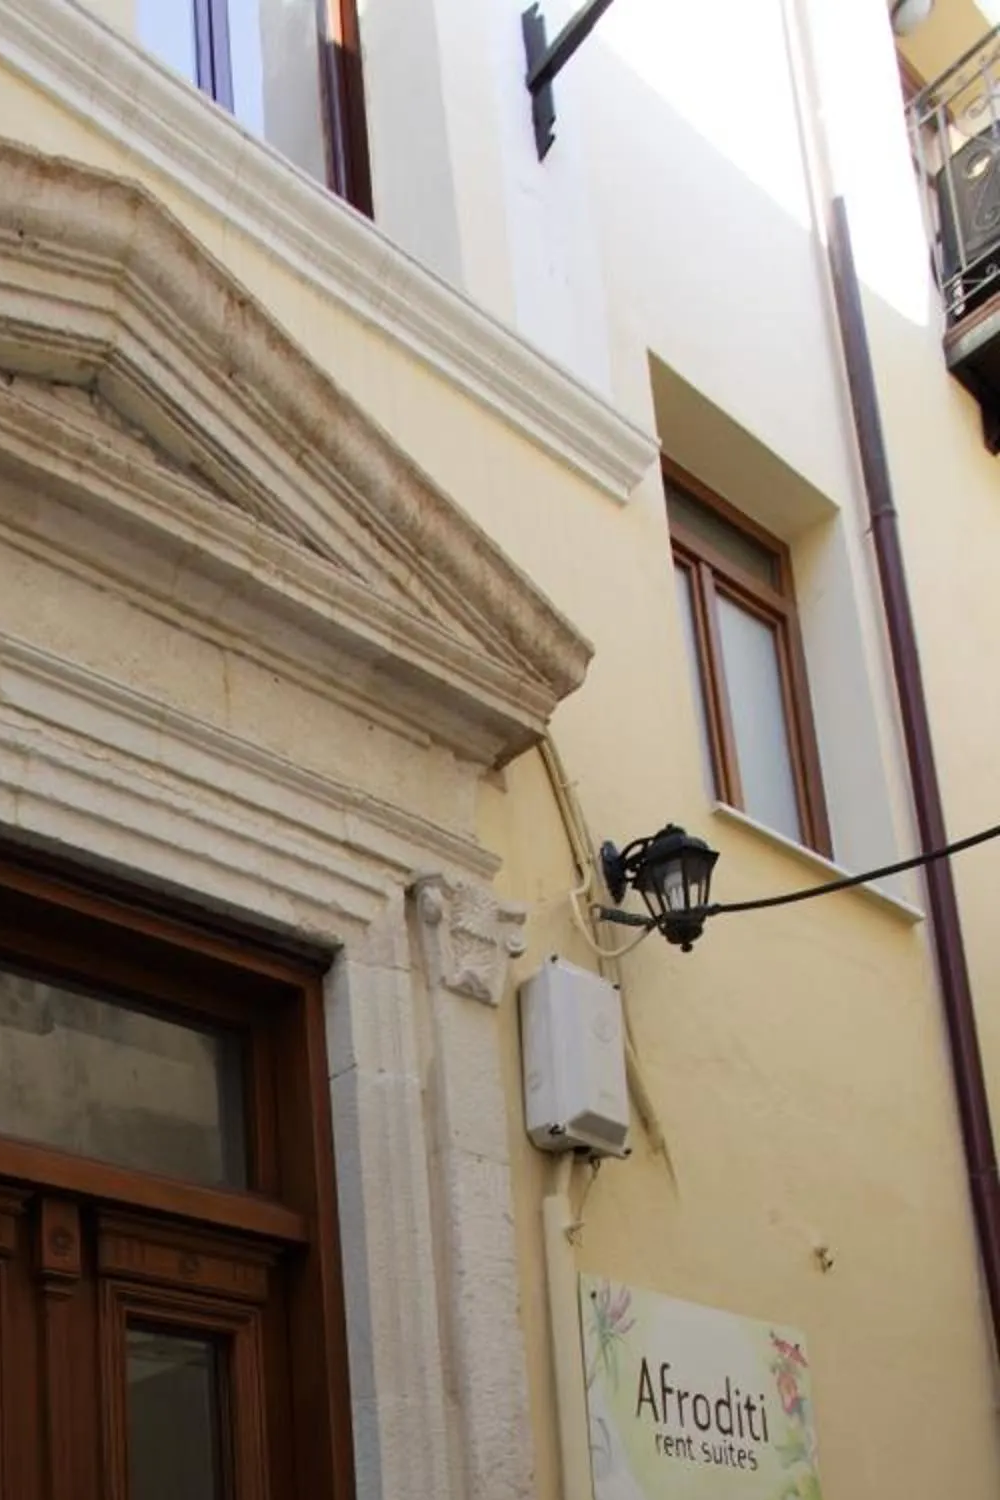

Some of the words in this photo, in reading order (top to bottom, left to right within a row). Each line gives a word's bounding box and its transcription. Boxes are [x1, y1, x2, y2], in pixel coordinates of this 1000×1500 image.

[636, 1357, 769, 1443] Afroditi
[655, 1433, 696, 1461] rent
[701, 1440, 758, 1471] suites
